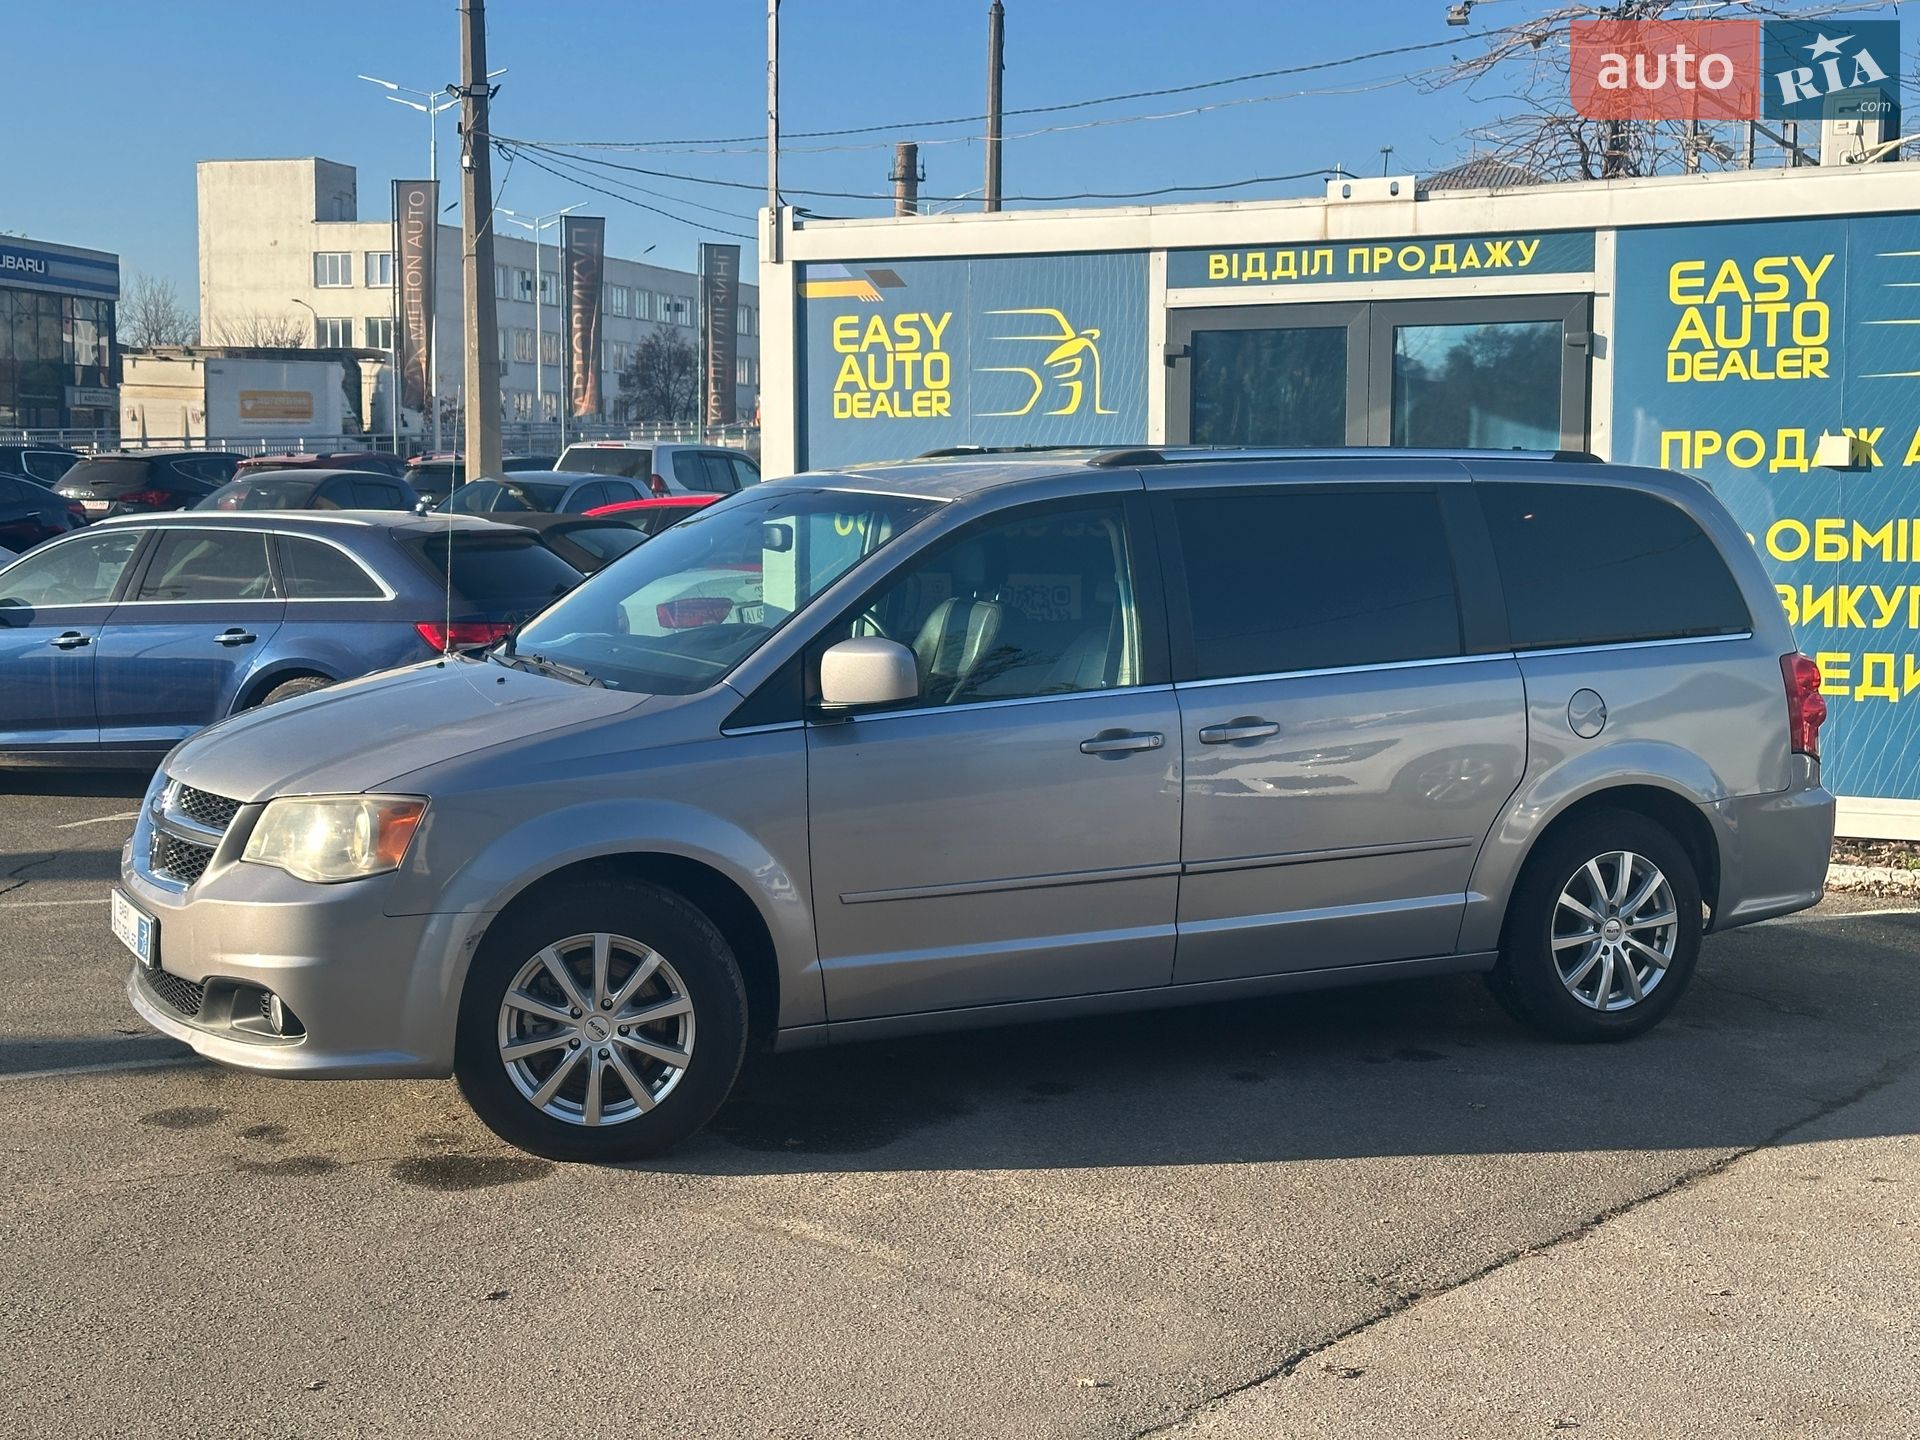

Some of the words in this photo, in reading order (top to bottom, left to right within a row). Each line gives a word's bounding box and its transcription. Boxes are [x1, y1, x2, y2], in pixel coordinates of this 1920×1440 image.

[407, 190, 426, 249] AUTO
[1208, 249, 1334, 281] ВІДДІЛ
[1348, 239, 1541, 274] ПРОДАЖУ
[1669, 254, 1836, 305] EASY
[406, 255, 426, 341] MILLION
[833, 312, 953, 353] EASY
[1667, 301, 1830, 351] AUTO
[833, 351, 950, 391] AUTO
[1667, 347, 1830, 383] DEALER
[833, 390, 952, 419] DEALER
[1660, 427, 1885, 473] ПРОДЖ
[1765, 518, 1920, 563] ОБМІ
